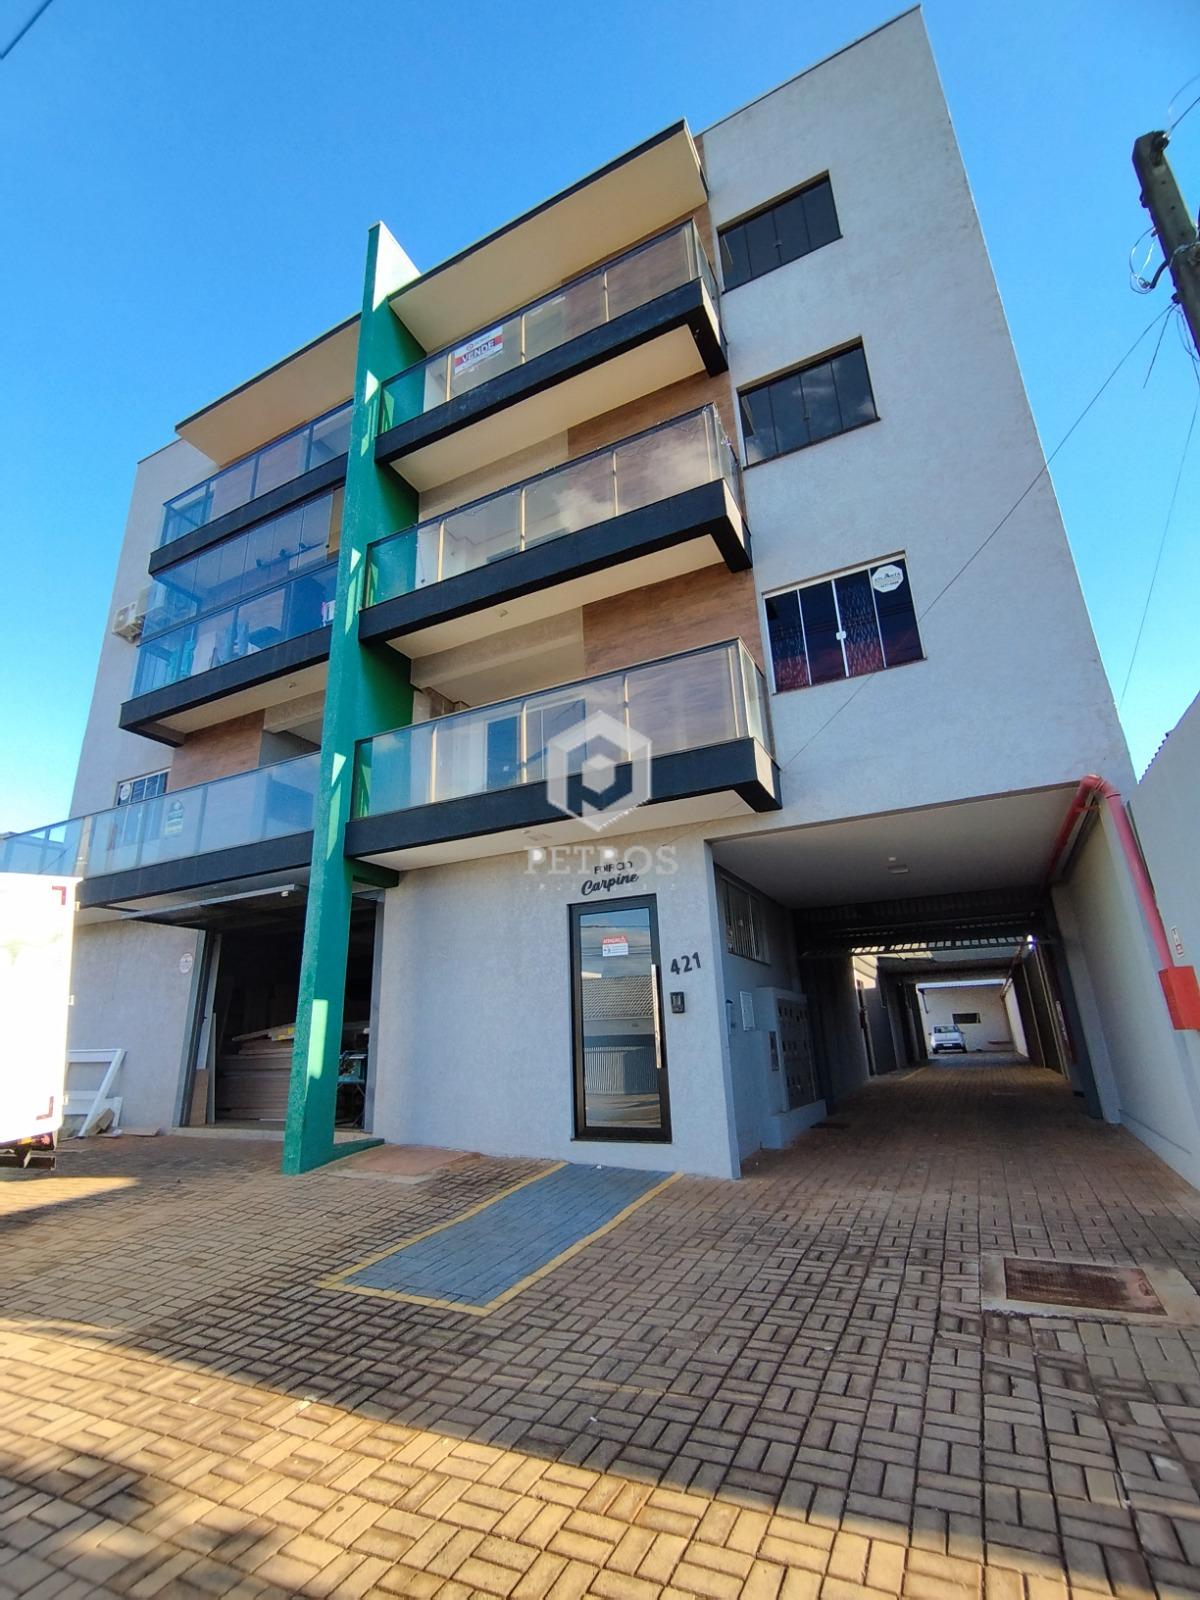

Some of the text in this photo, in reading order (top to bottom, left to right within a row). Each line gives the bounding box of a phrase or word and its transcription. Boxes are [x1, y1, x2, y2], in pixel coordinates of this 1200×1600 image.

[462, 340, 496, 362] VENDE
[581, 871, 639, 896] Carpine
[670, 952, 702, 975] 421
